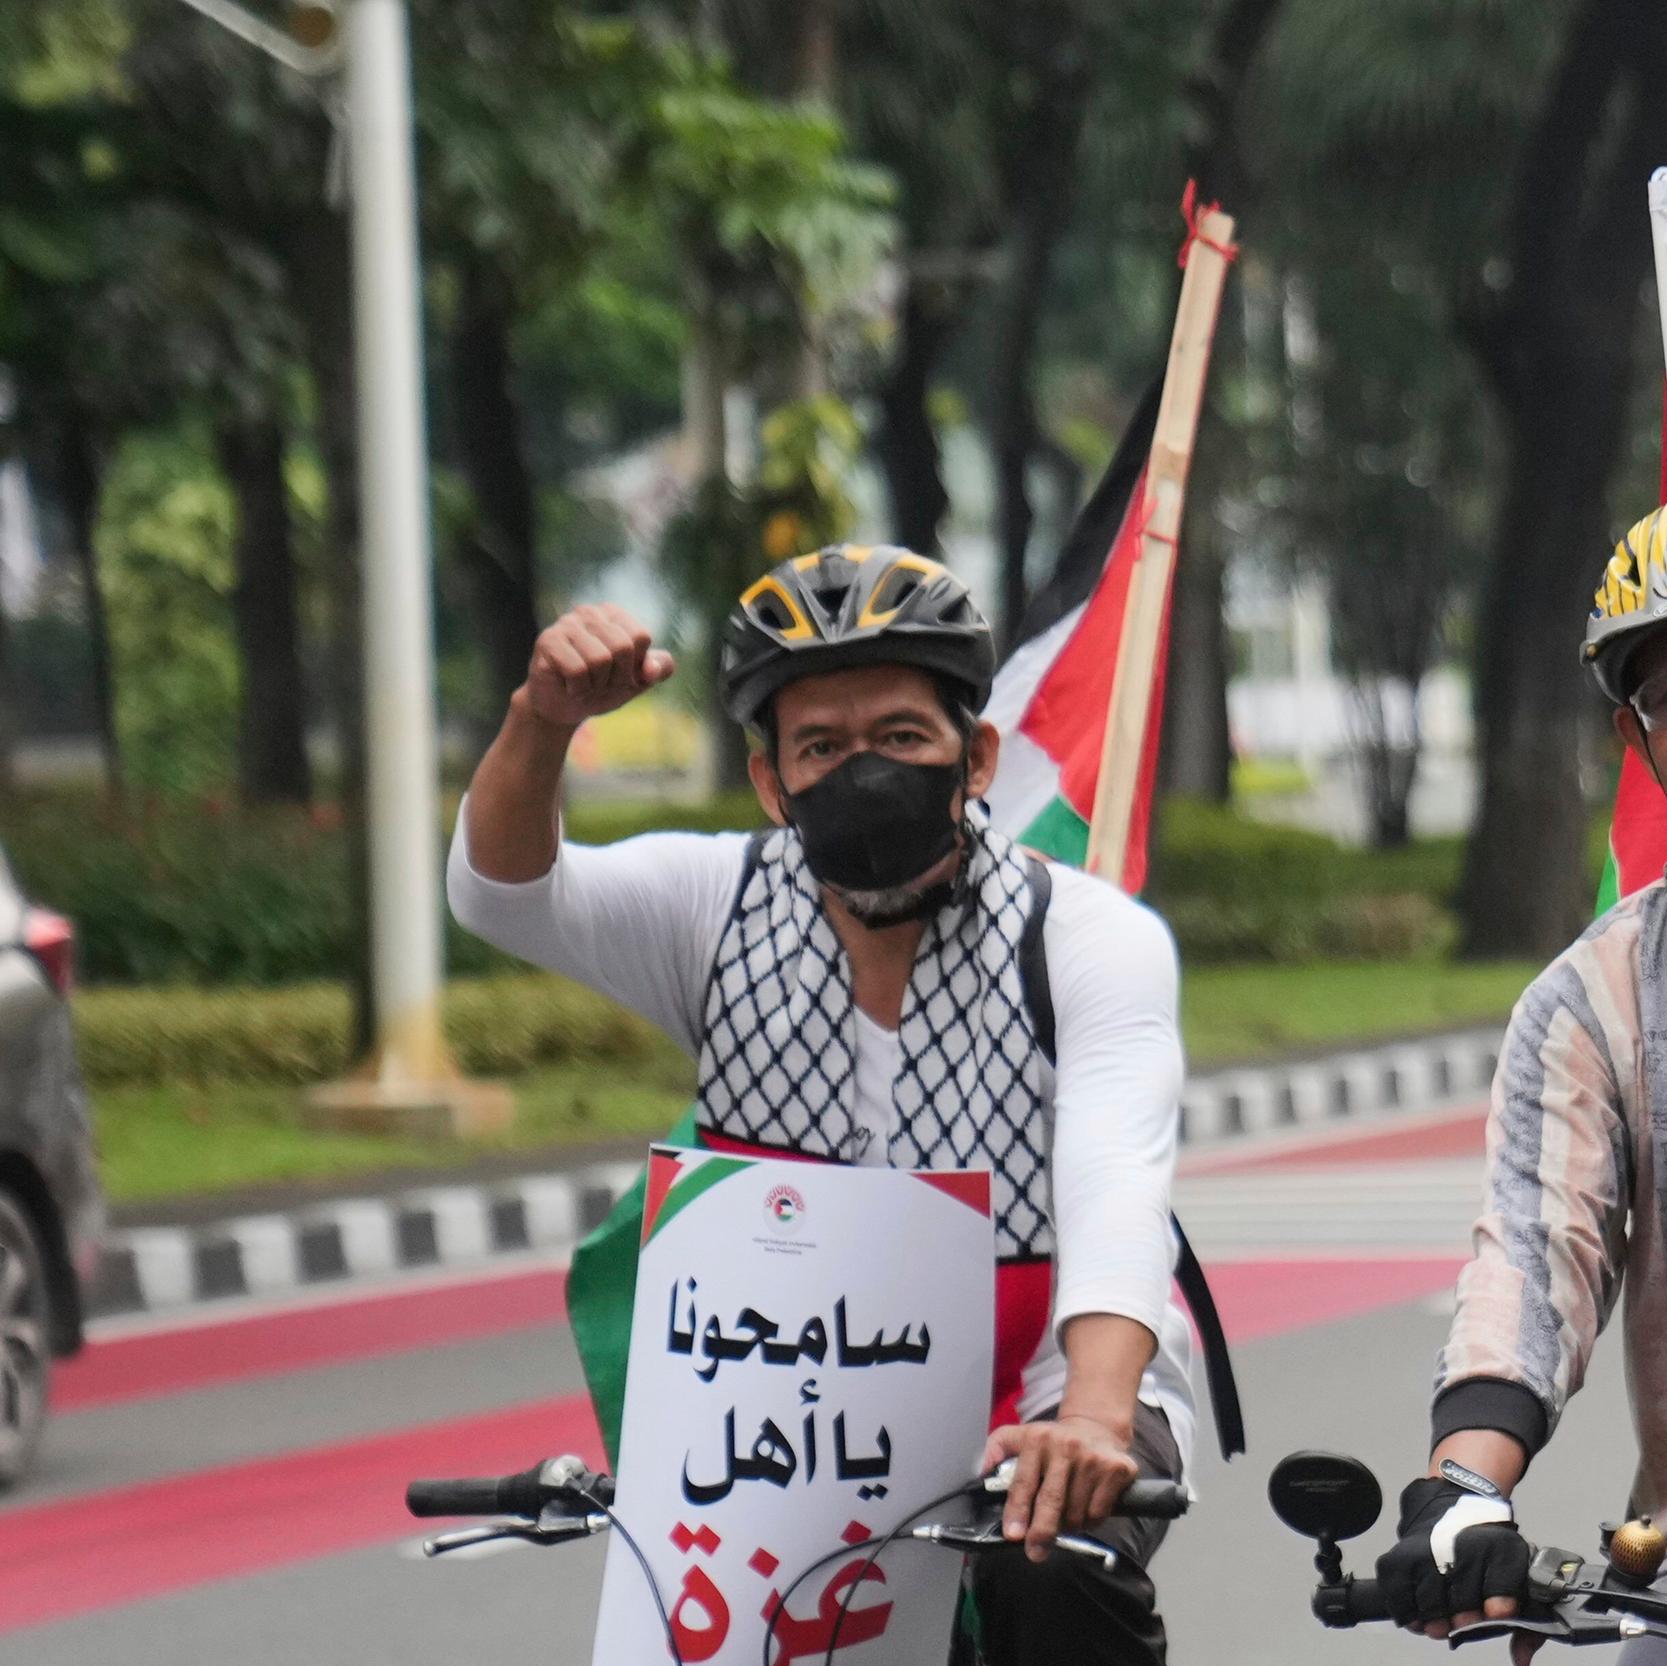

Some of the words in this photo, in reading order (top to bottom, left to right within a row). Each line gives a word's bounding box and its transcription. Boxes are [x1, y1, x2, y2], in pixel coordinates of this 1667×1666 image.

[665, 1276, 931, 1383] سامحونا
[681, 1377, 820, 1506] أهل
[833, 1409, 891, 1501] يا
